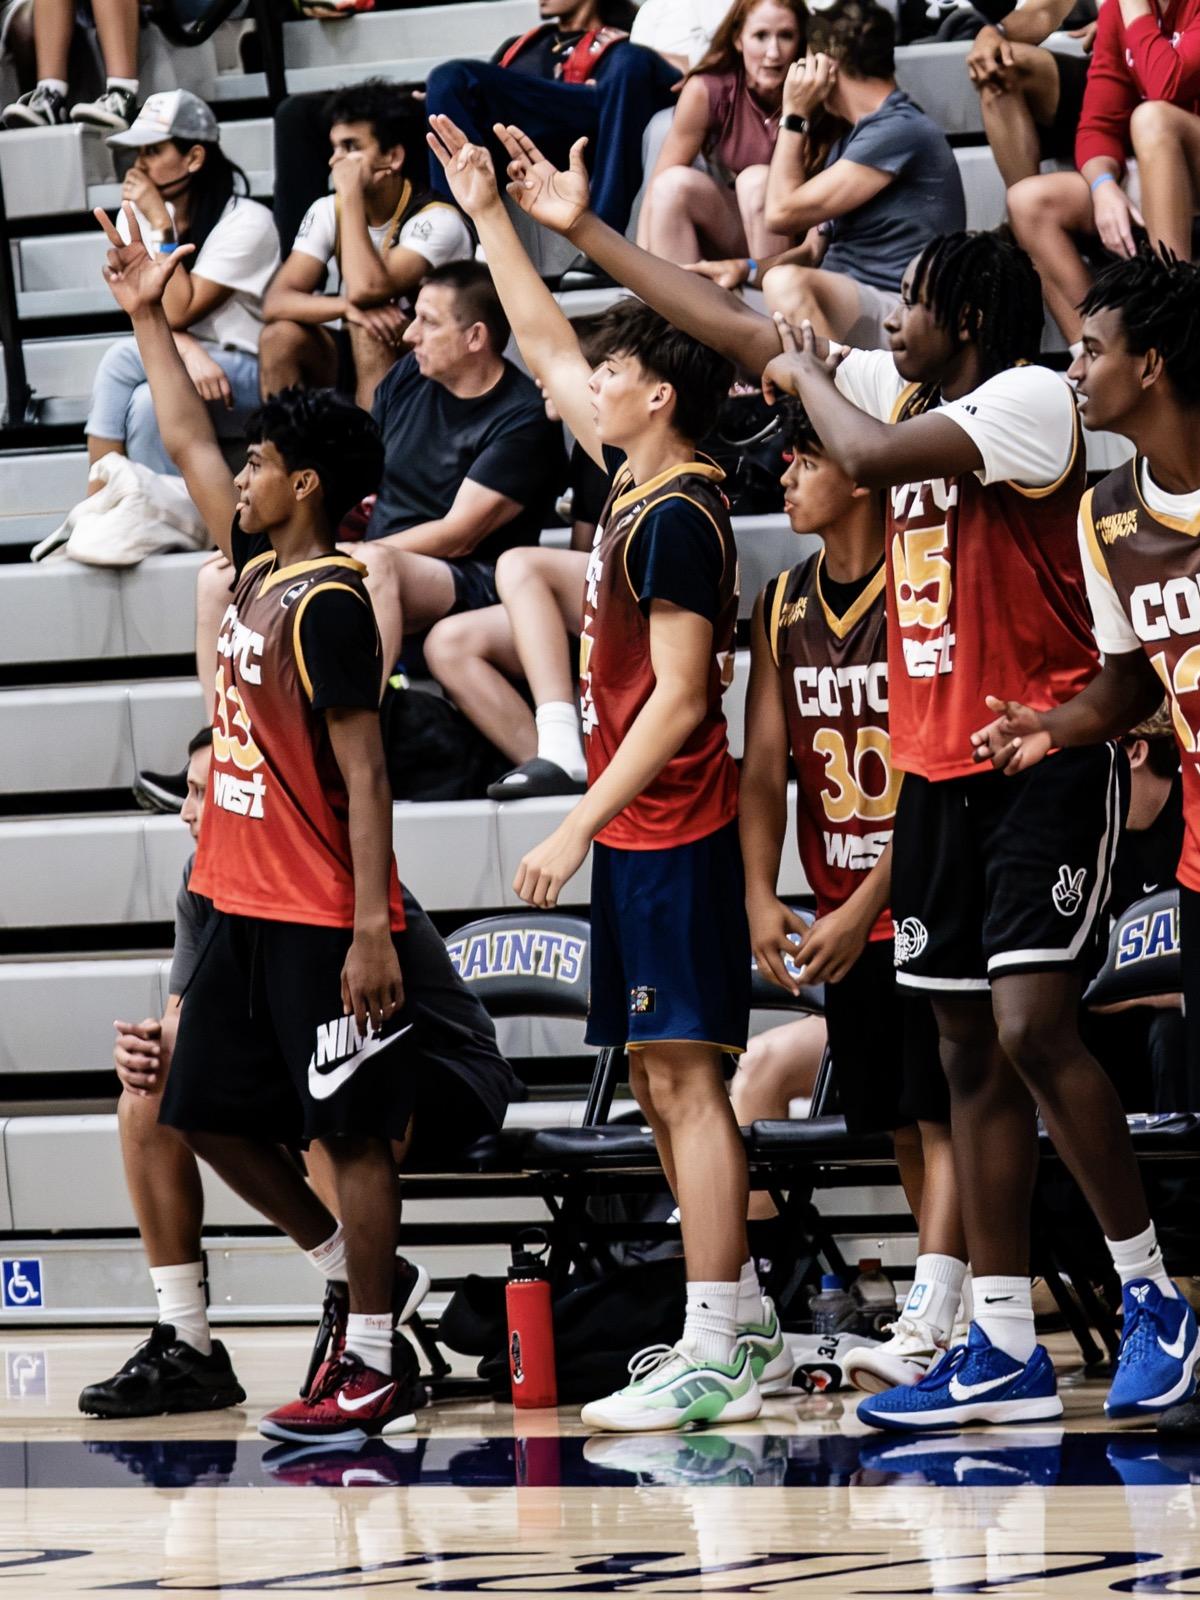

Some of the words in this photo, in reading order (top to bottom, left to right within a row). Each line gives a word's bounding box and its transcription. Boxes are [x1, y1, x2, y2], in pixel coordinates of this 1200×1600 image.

[212, 664, 265, 771] 33
[793, 665, 889, 718] COTC
[812, 726, 904, 823] 30
[823, 829, 895, 871] wes
[446, 929, 587, 984] SAINTS
